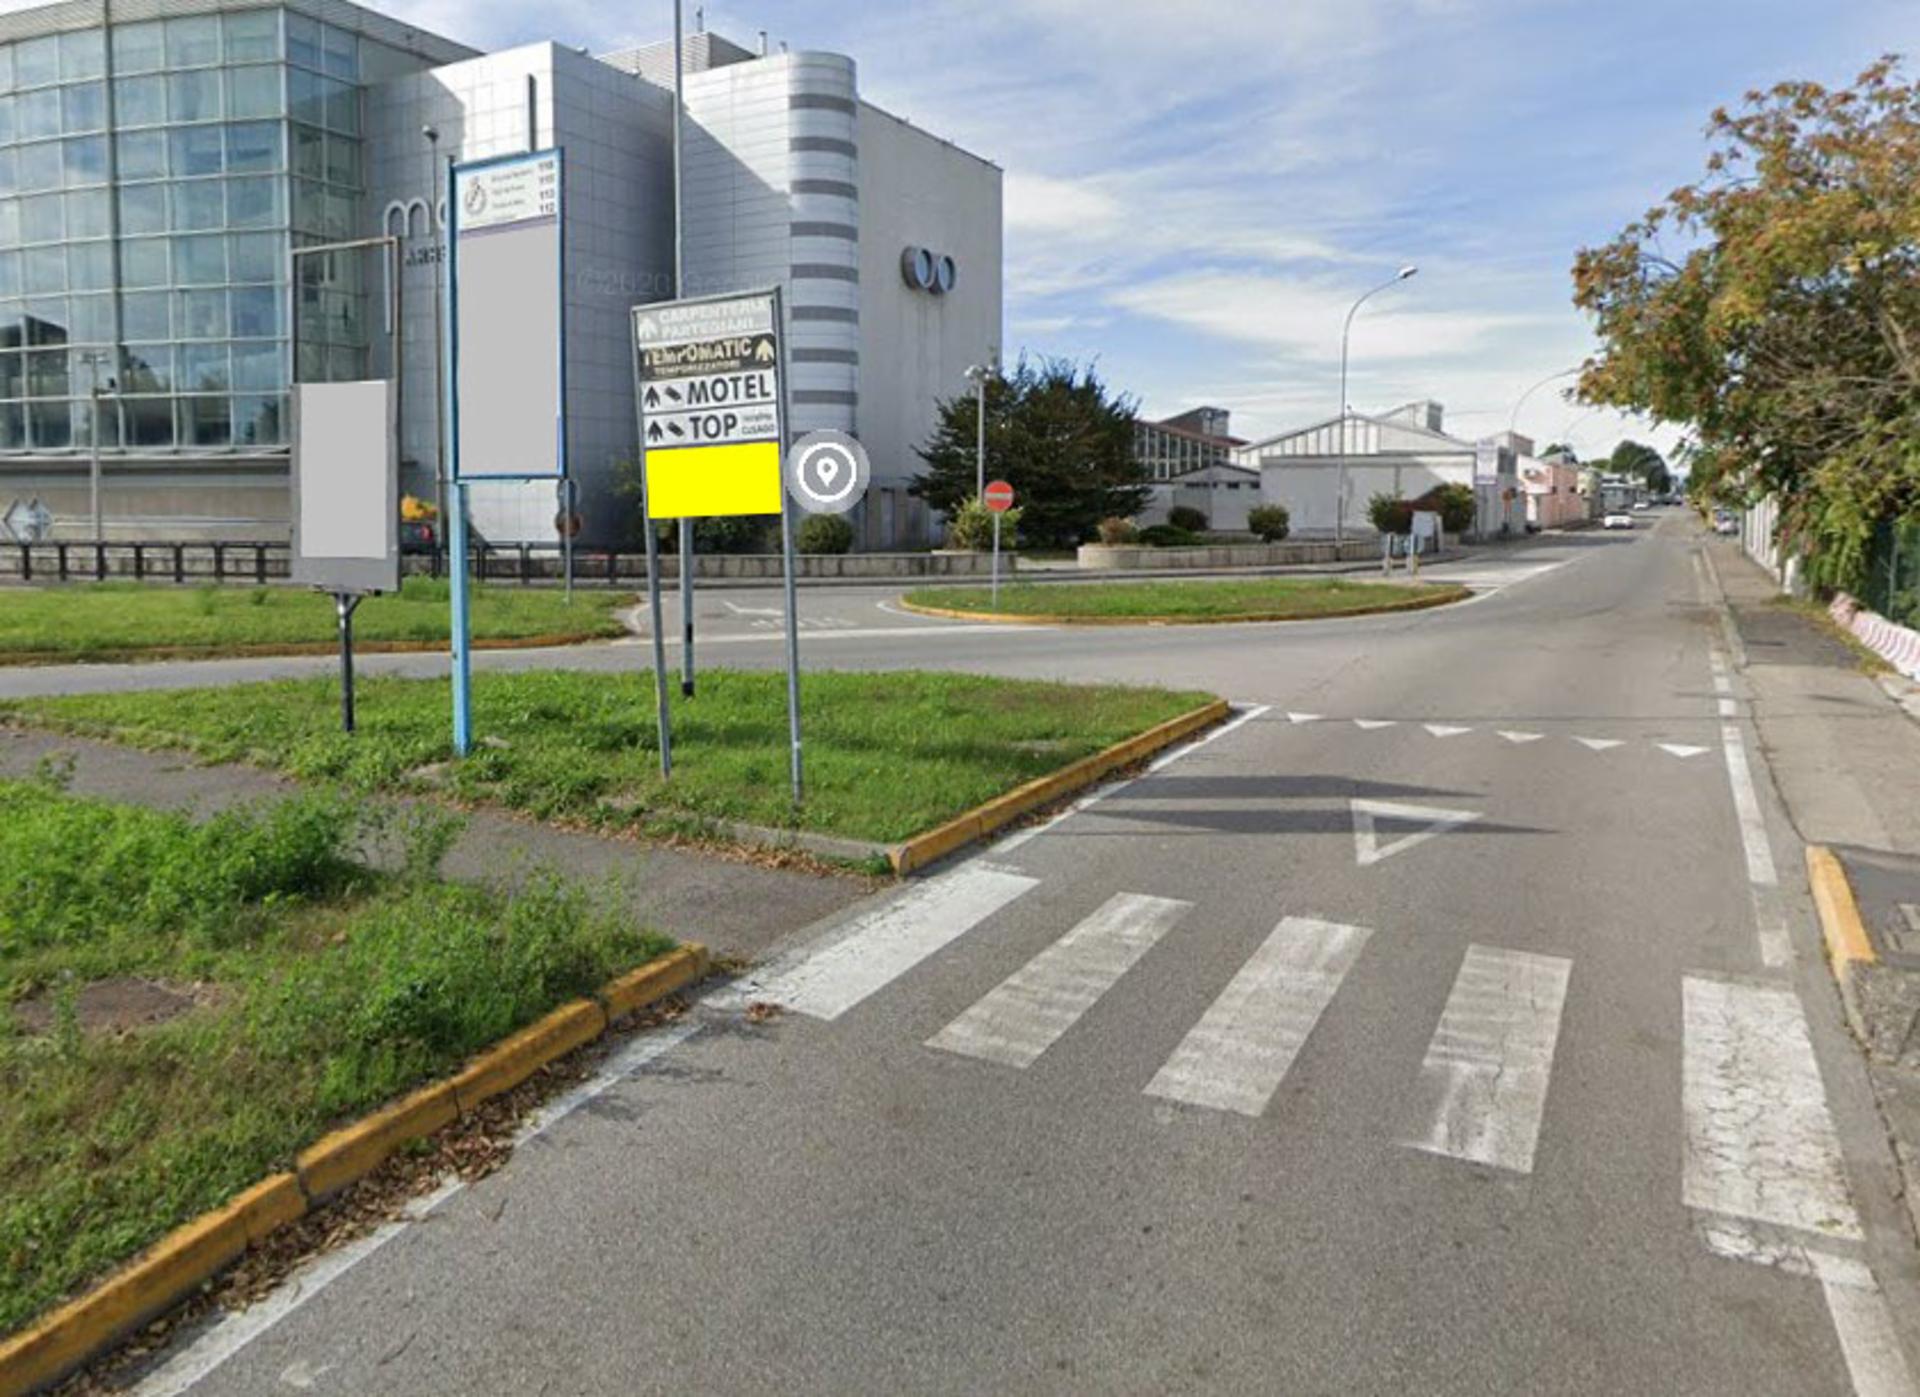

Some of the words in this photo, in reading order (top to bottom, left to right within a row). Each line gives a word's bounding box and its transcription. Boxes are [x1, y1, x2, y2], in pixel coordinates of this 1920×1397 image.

[644, 337, 752, 367] TEMPOMATIC
[687, 374, 771, 405] MOTEL
[689, 413, 738, 439] TOP
